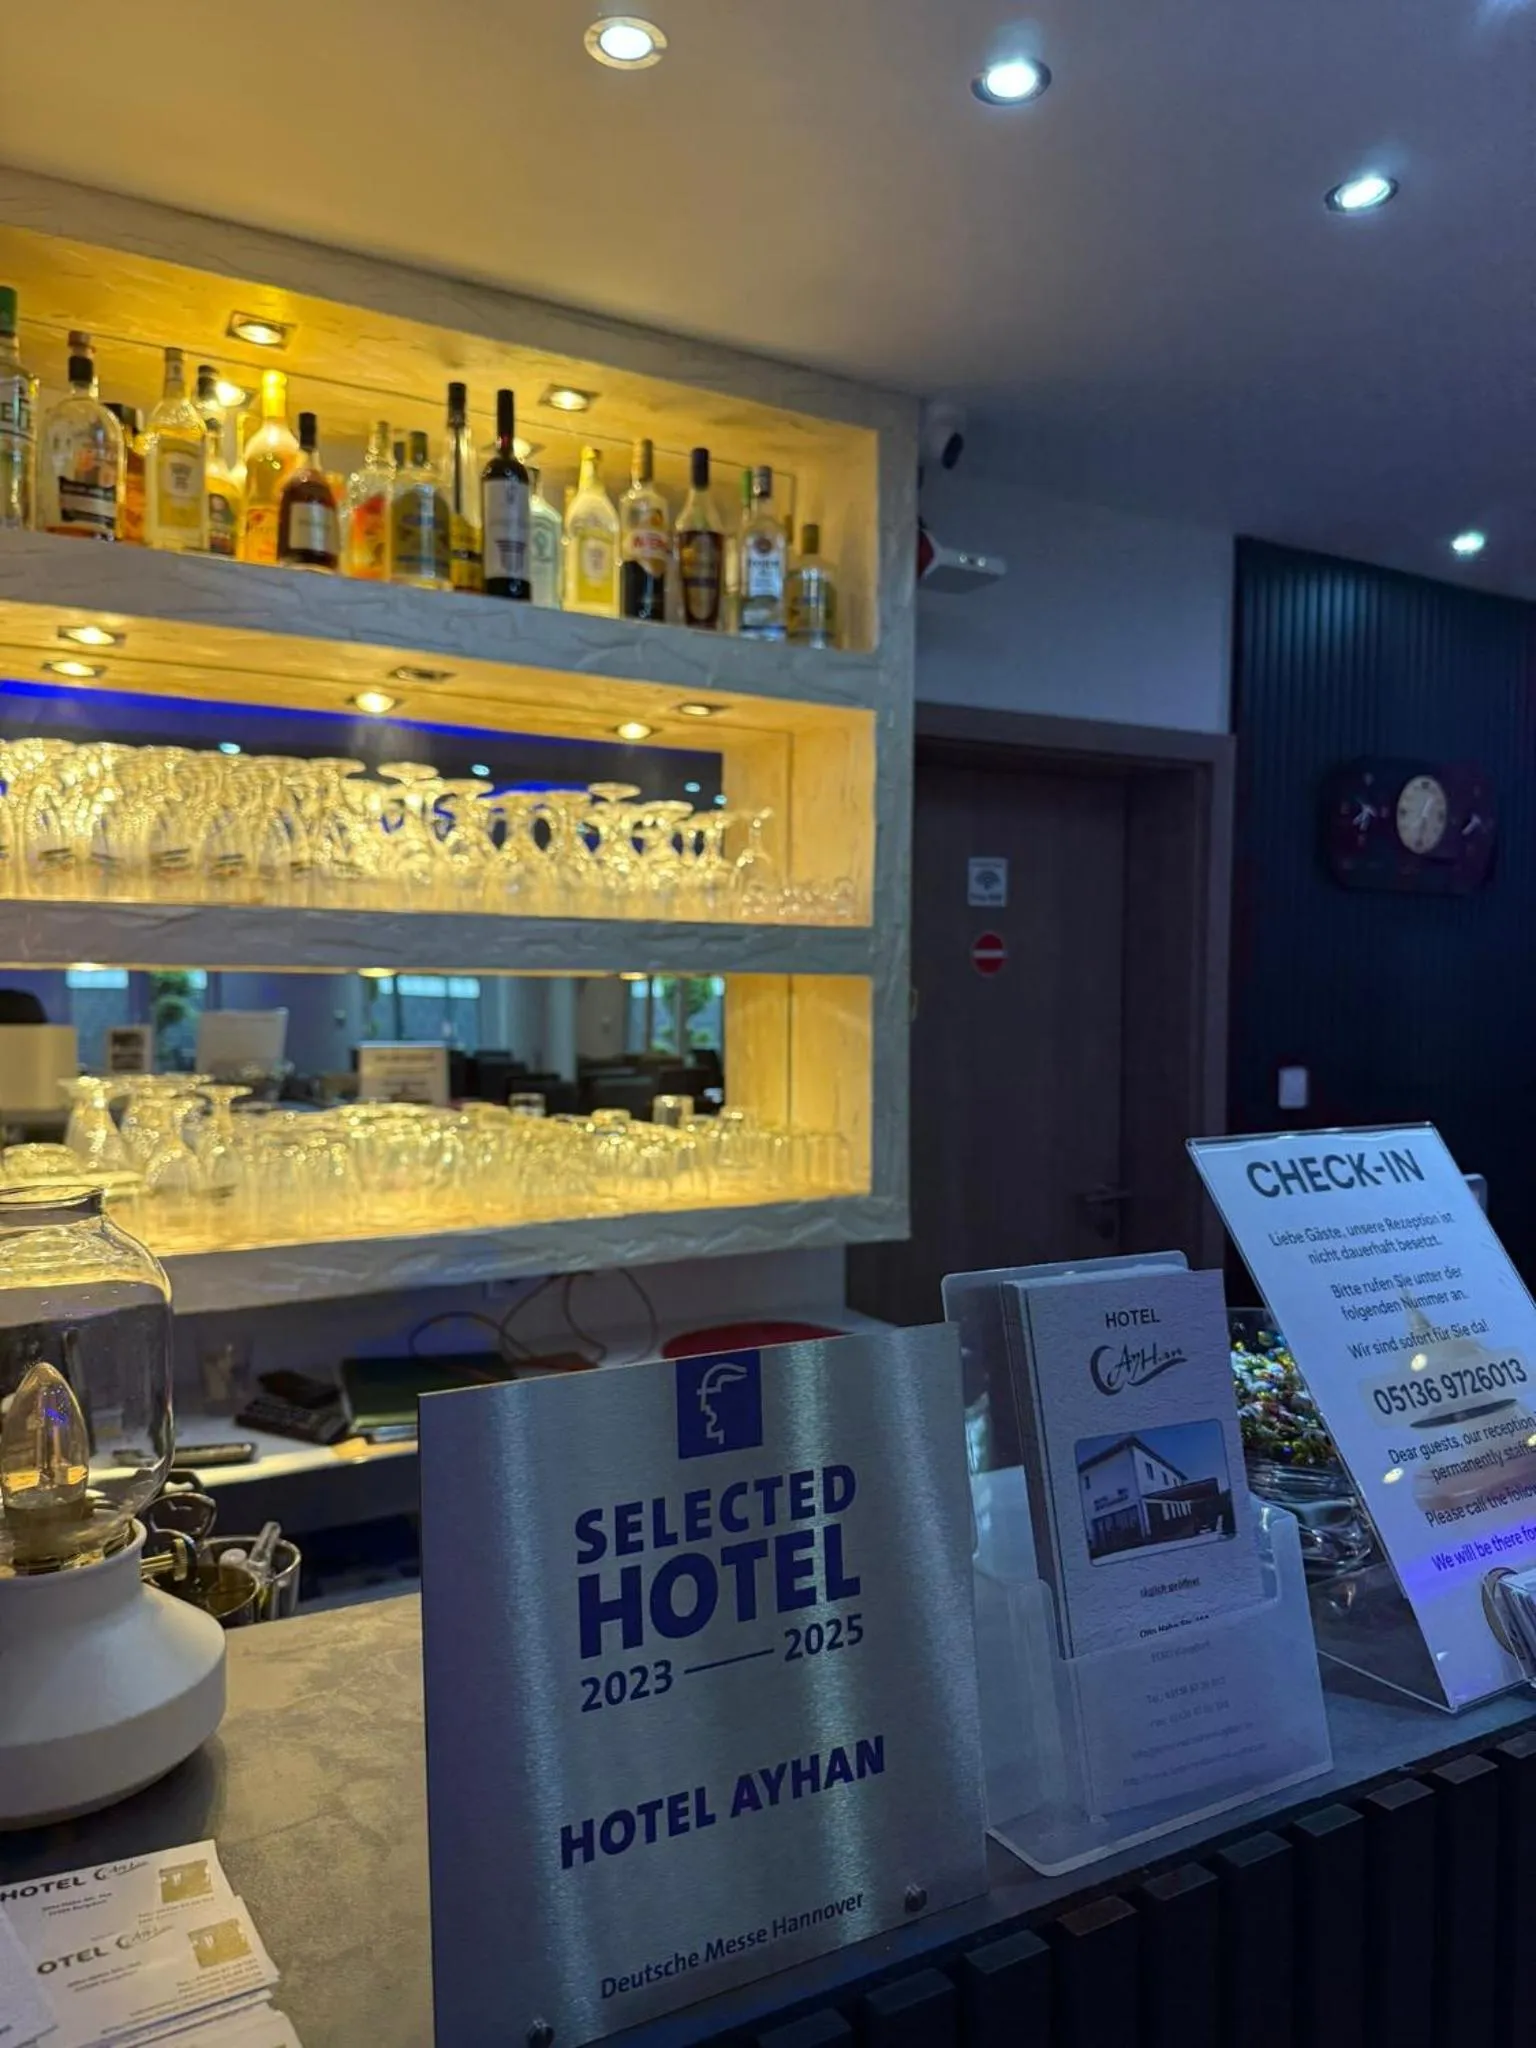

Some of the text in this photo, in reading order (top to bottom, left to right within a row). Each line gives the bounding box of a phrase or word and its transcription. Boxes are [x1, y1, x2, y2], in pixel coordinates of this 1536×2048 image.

[1246, 1149, 1425, 1198] CHECK-IN
[1268, 1232, 1303, 1247] Liebe
[1345, 1223, 1385, 1237] unsere
[1383, 1214, 1439, 1231] Rezeption
[1308, 1249, 1341, 1265] nicht
[1341, 1242, 1398, 1261] dauerhaft
[1330, 1264, 1462, 1299] Bitte rufen Sie unter der
[1105, 1308, 1160, 1329] HOTEL
[1340, 1299, 1404, 1321] folgenden
[1401, 1293, 1449, 1311] Nummer
[1346, 1343, 1370, 1359] Wir
[1373, 1337, 1399, 1354] sind
[1399, 1328, 1433, 1347] sofort
[1431, 1325, 1451, 1342] für
[1450, 1323, 1470, 1338] Sie
[1373, 1358, 1529, 1416] 05136 9726013
[1388, 1415, 1535, 1465] Dear guests, our reception
[1431, 1449, 1504, 1484] permanently
[575, 1464, 856, 1564] SELECTED
[1424, 1506, 1466, 1528] Please
[1465, 1496, 1487, 1515] call
[1486, 1492, 1508, 1509] the
[1430, 1552, 1455, 1572] We
[1454, 1542, 1477, 1565] will
[1475, 1540, 1493, 1558] be
[1490, 1533, 1523, 1553] there
[578, 1523, 860, 1660] HOTEL
[581, 1613, 864, 1713] 2023 2025
[560, 1735, 885, 1870] HOTEL AYHAN
[601, 1892, 865, 1999] Deutsche Messe Hannover
